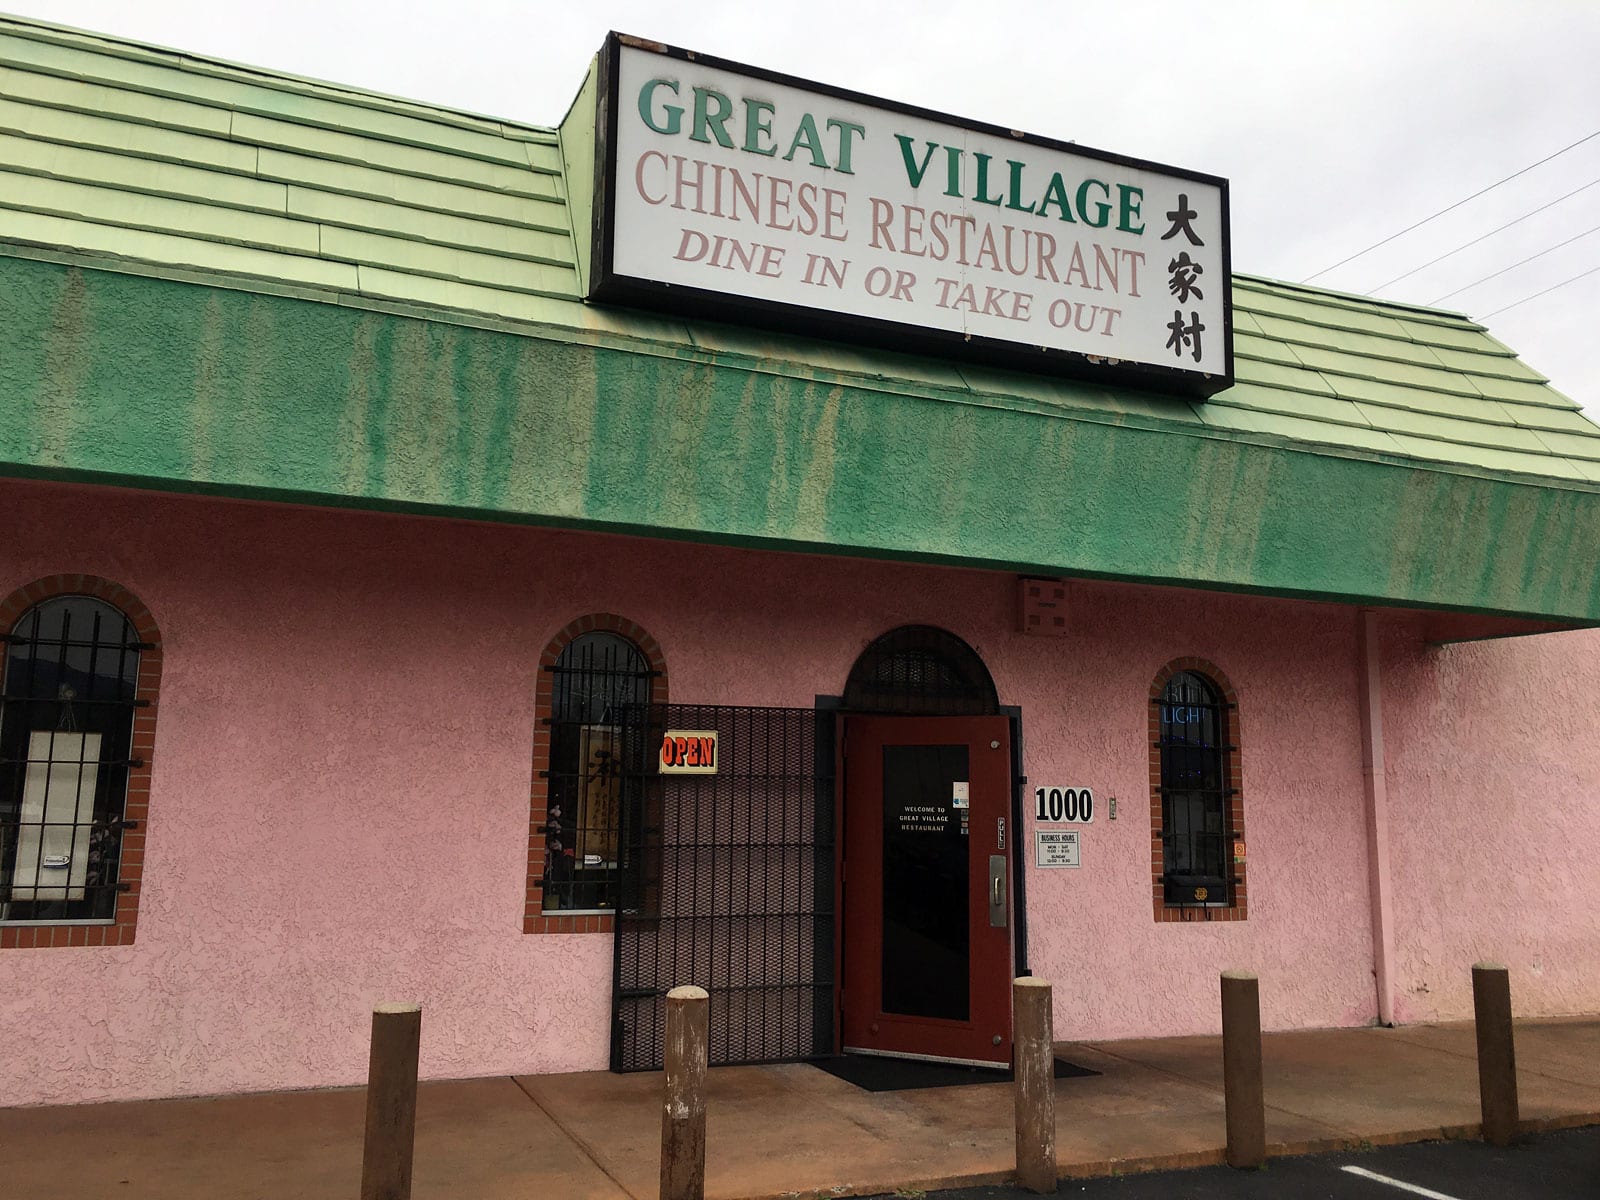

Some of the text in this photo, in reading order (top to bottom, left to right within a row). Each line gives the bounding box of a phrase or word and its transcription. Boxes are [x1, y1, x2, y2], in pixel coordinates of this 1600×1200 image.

[638, 79, 1145, 235] GREAT VILLAGE
[635, 151, 1146, 297] CHINESE RESTAURANT
[1161, 194, 1205, 362] 大家村
[673, 228, 1122, 336] DINE IN OR TAKE OUT
[662, 736, 715, 767] OPEN
[1036, 788, 1093, 821] 1000
[901, 824, 945, 832] RESTAURANT
